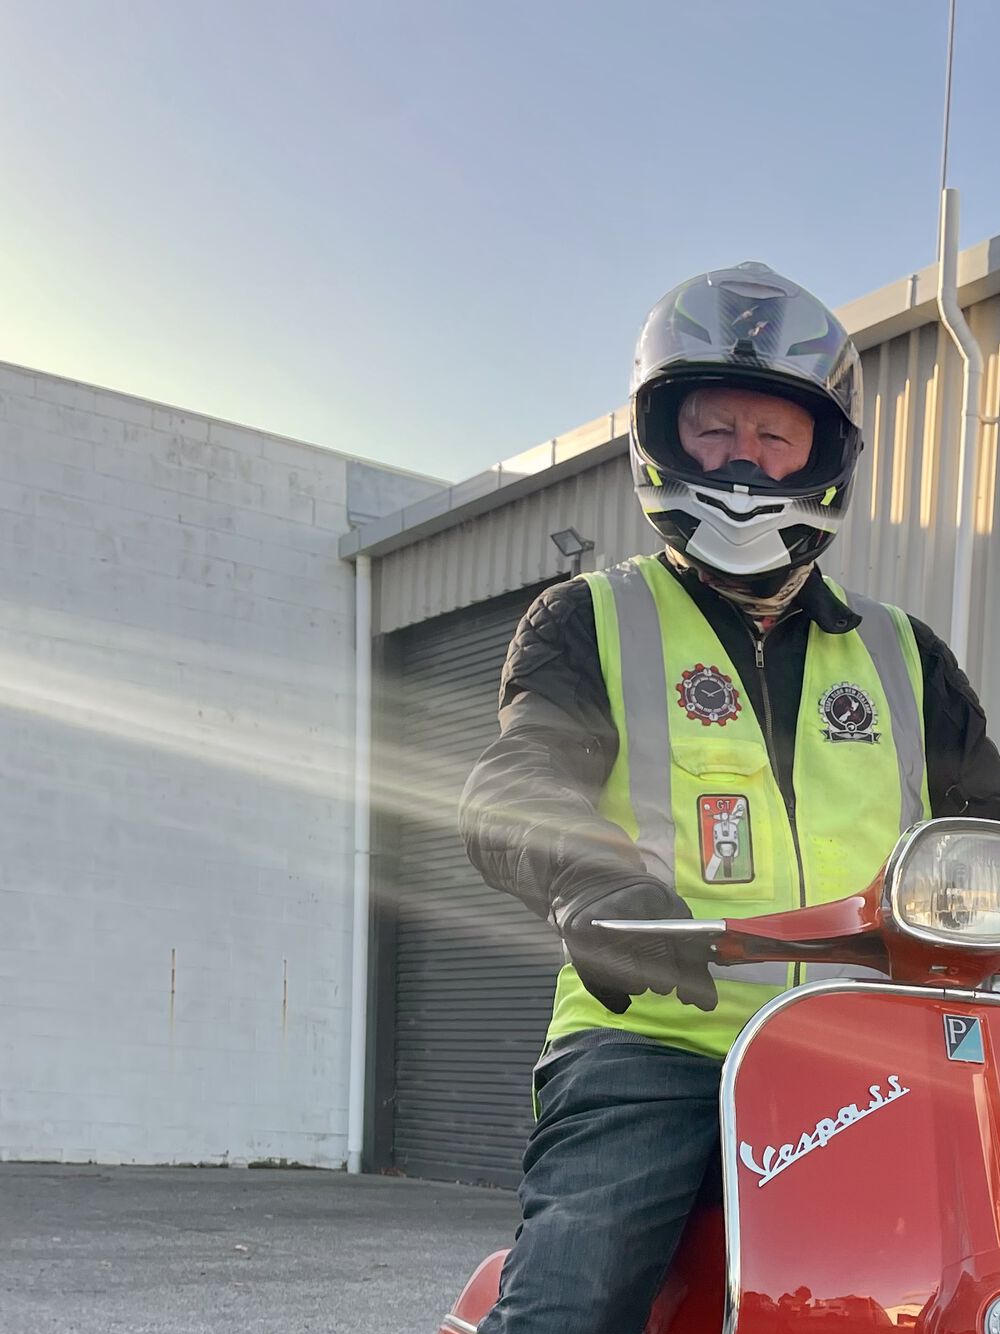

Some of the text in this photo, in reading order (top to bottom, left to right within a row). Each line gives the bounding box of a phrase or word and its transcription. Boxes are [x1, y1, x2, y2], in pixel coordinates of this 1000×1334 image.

[716, 799, 730, 810] GT
[948, 1019, 968, 1044] P
[739, 1102, 866, 1188] Vespa
